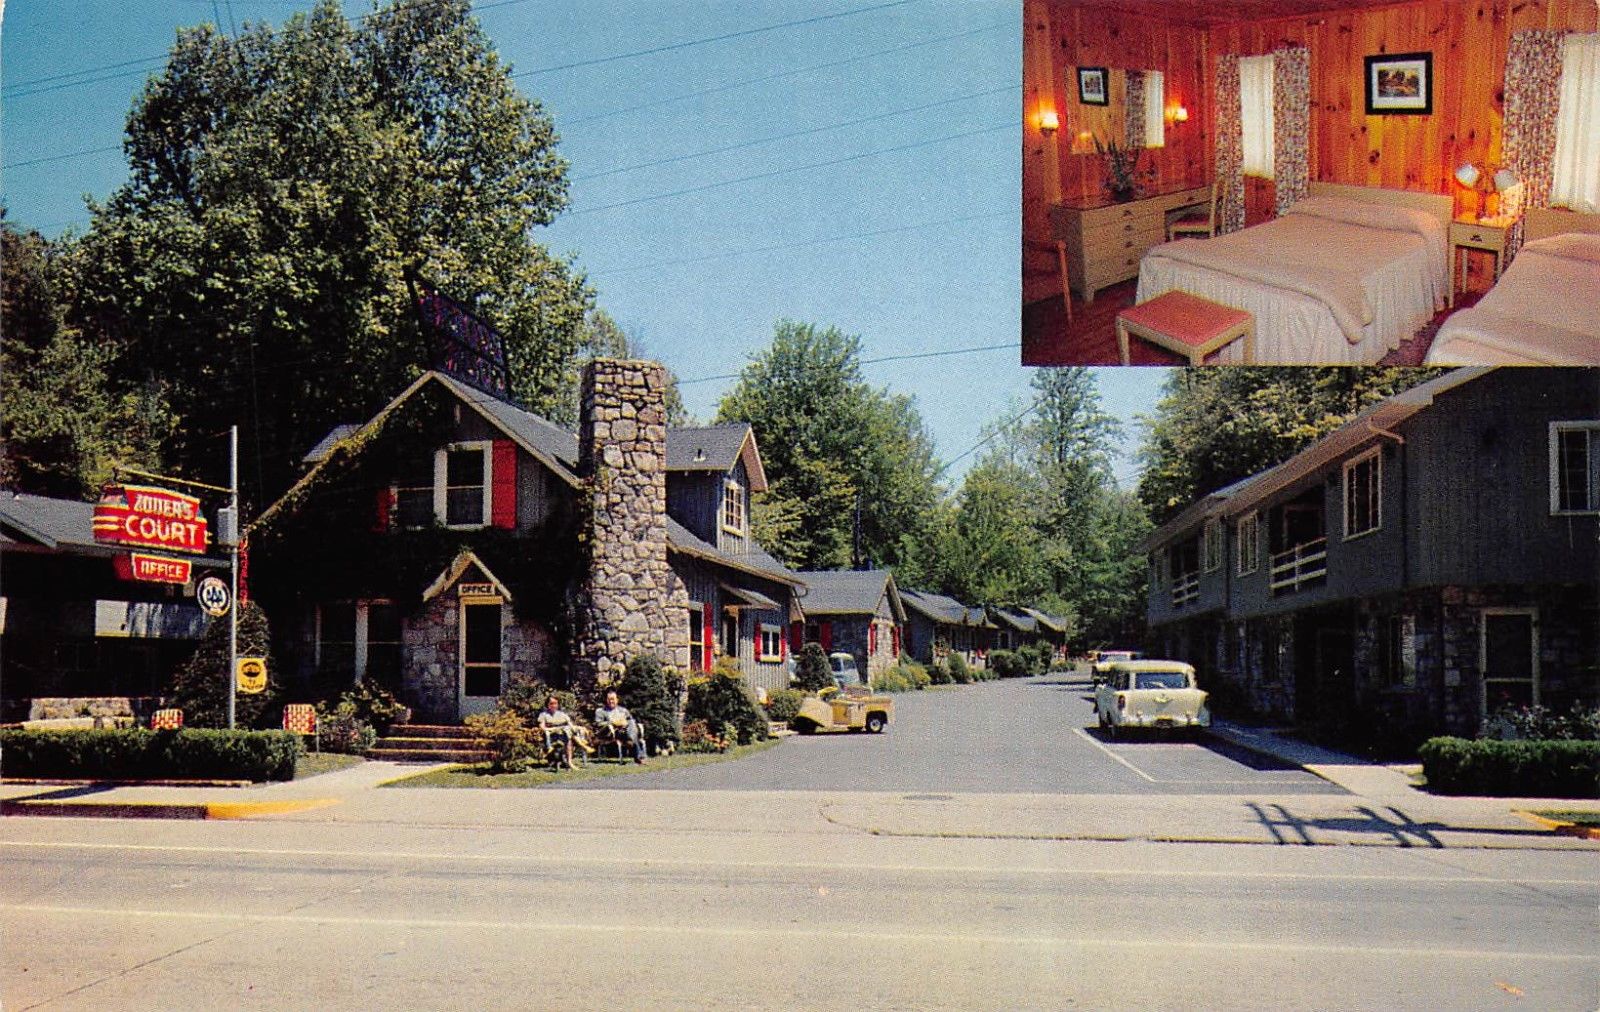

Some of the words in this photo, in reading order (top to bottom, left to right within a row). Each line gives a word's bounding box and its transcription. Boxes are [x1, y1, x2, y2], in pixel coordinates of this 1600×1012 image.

[125, 515, 198, 545] COURT
[141, 560, 184, 578] OFFICE
[462, 585, 492, 594] OFFICE
